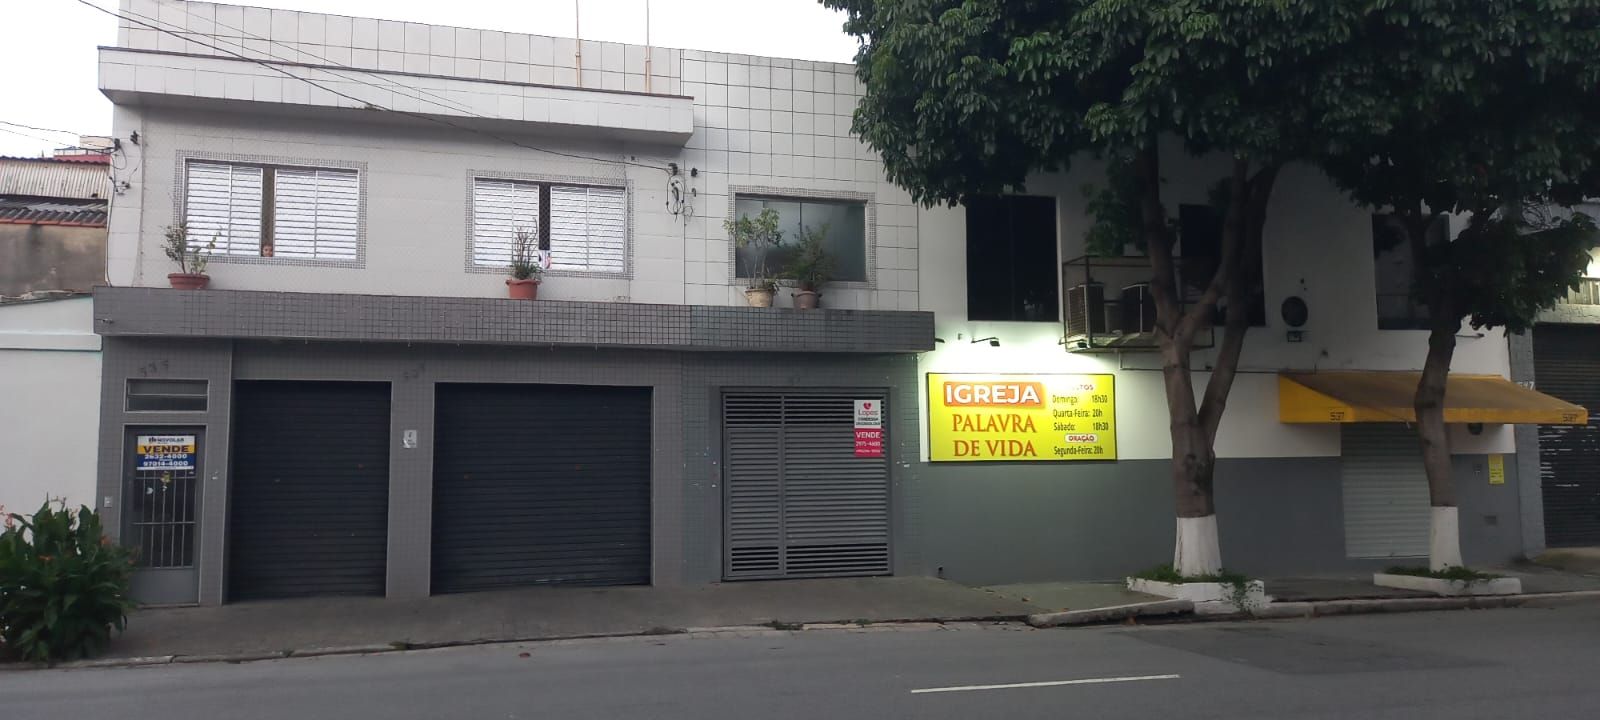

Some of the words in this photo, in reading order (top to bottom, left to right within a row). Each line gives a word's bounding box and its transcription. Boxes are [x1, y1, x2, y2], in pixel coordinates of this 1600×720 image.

[945, 383, 1041, 405] IGREJA
[1091, 395, 1108, 404] 18h30
[1092, 409, 1103, 418] 20h
[952, 413, 1038, 433] PALAVRA
[1093, 422, 1109, 431] 18h30
[1068, 434, 1095, 443] ORAÇÃO
[143, 445, 190, 453] VENDE
[954, 440, 980, 457] DE
[985, 439, 1038, 457] VIDA
[1093, 446, 1104, 455] 20h
